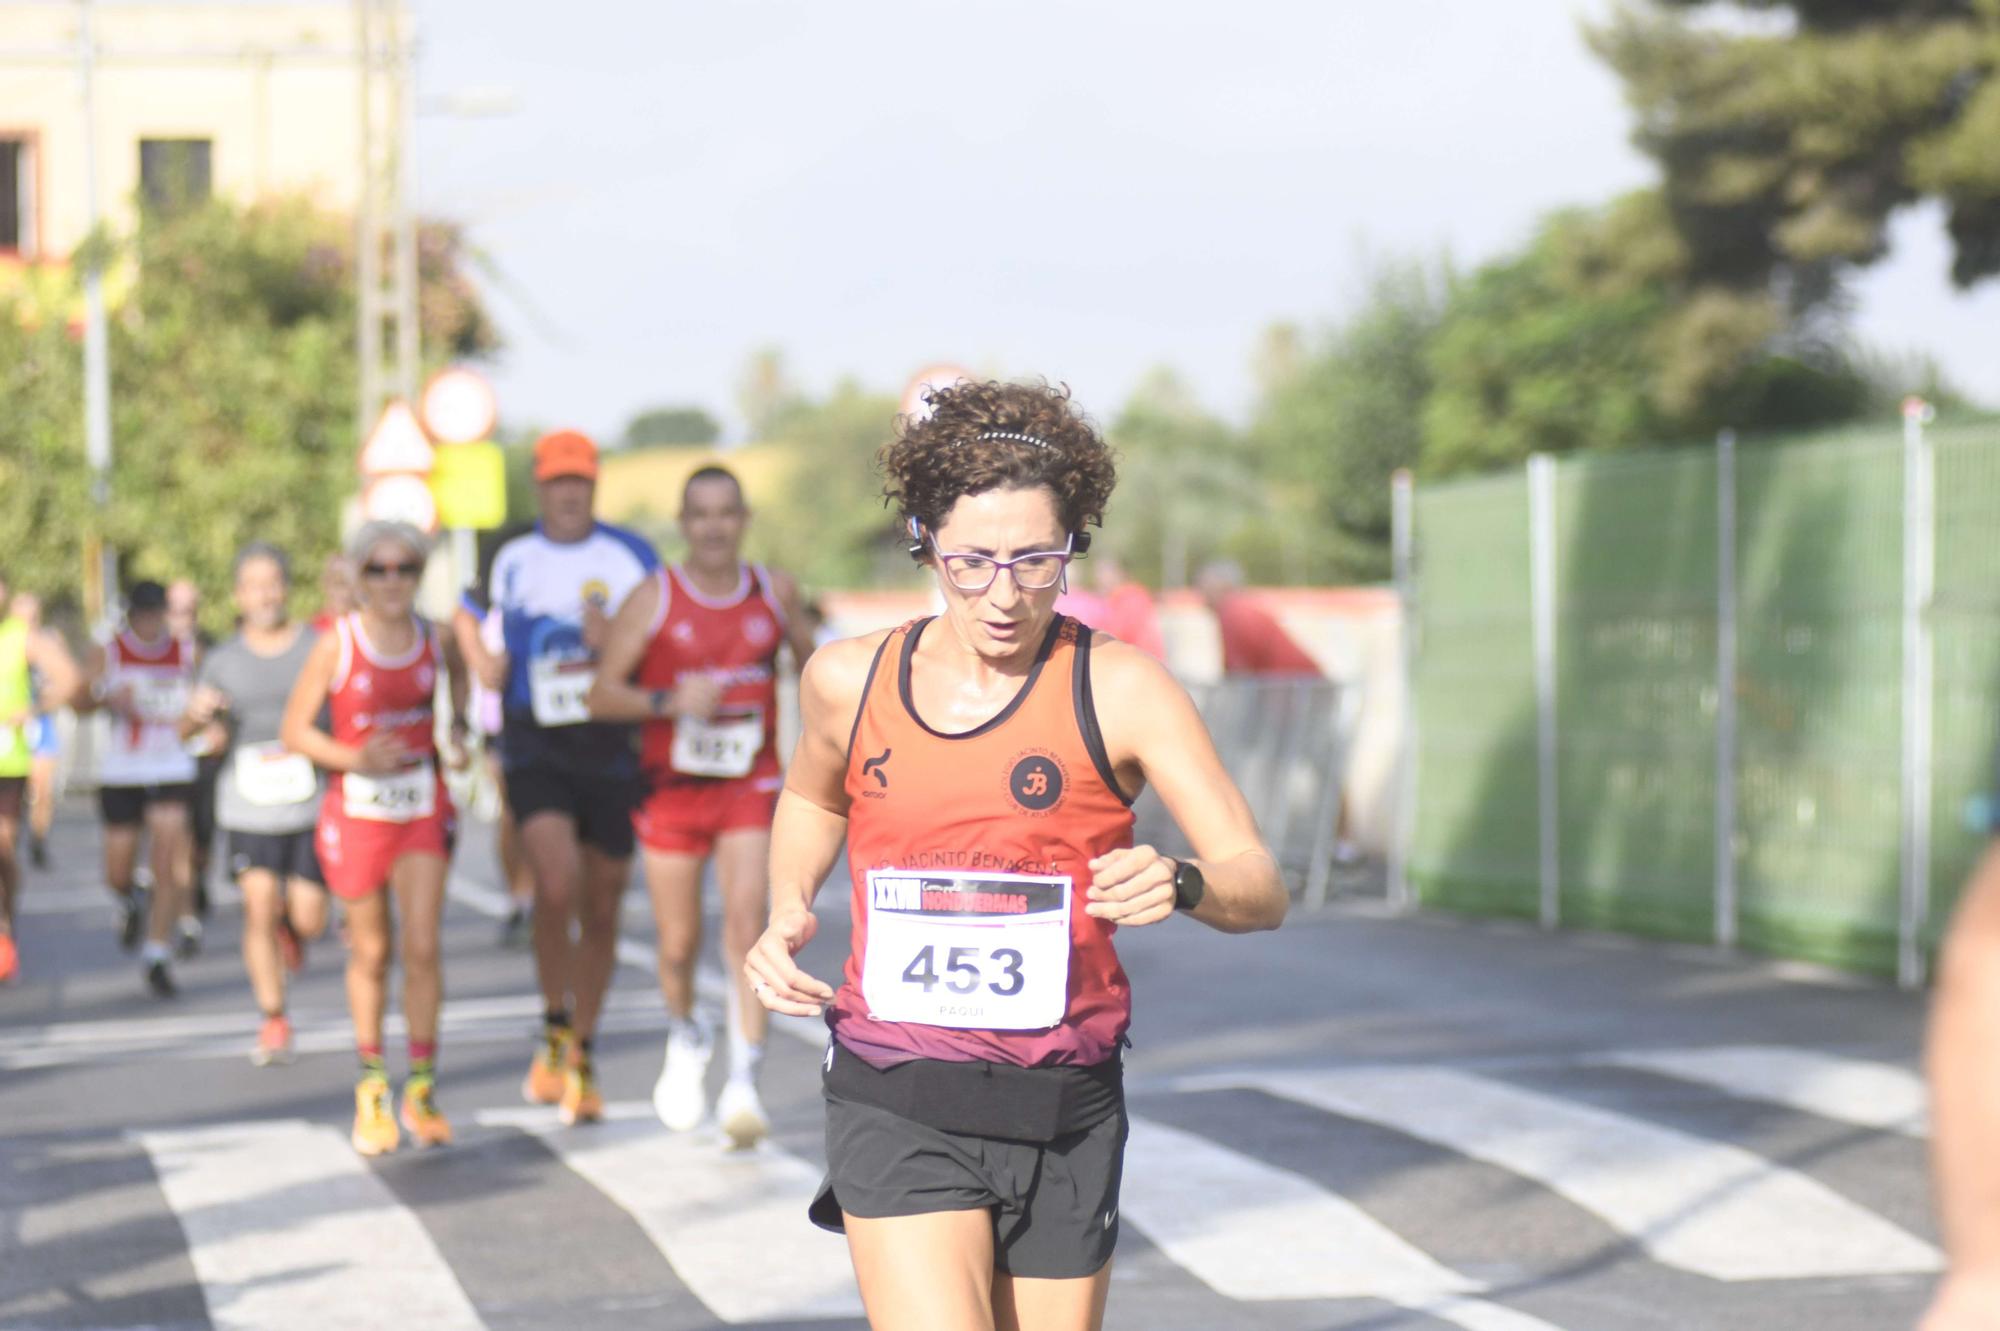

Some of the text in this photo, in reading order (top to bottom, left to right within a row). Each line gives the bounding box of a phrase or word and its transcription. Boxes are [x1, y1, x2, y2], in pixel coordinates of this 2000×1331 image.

[902, 851, 967, 869] JACINTO
[902, 945, 1025, 996] 453
[940, 1005, 984, 1017] PAQUI
